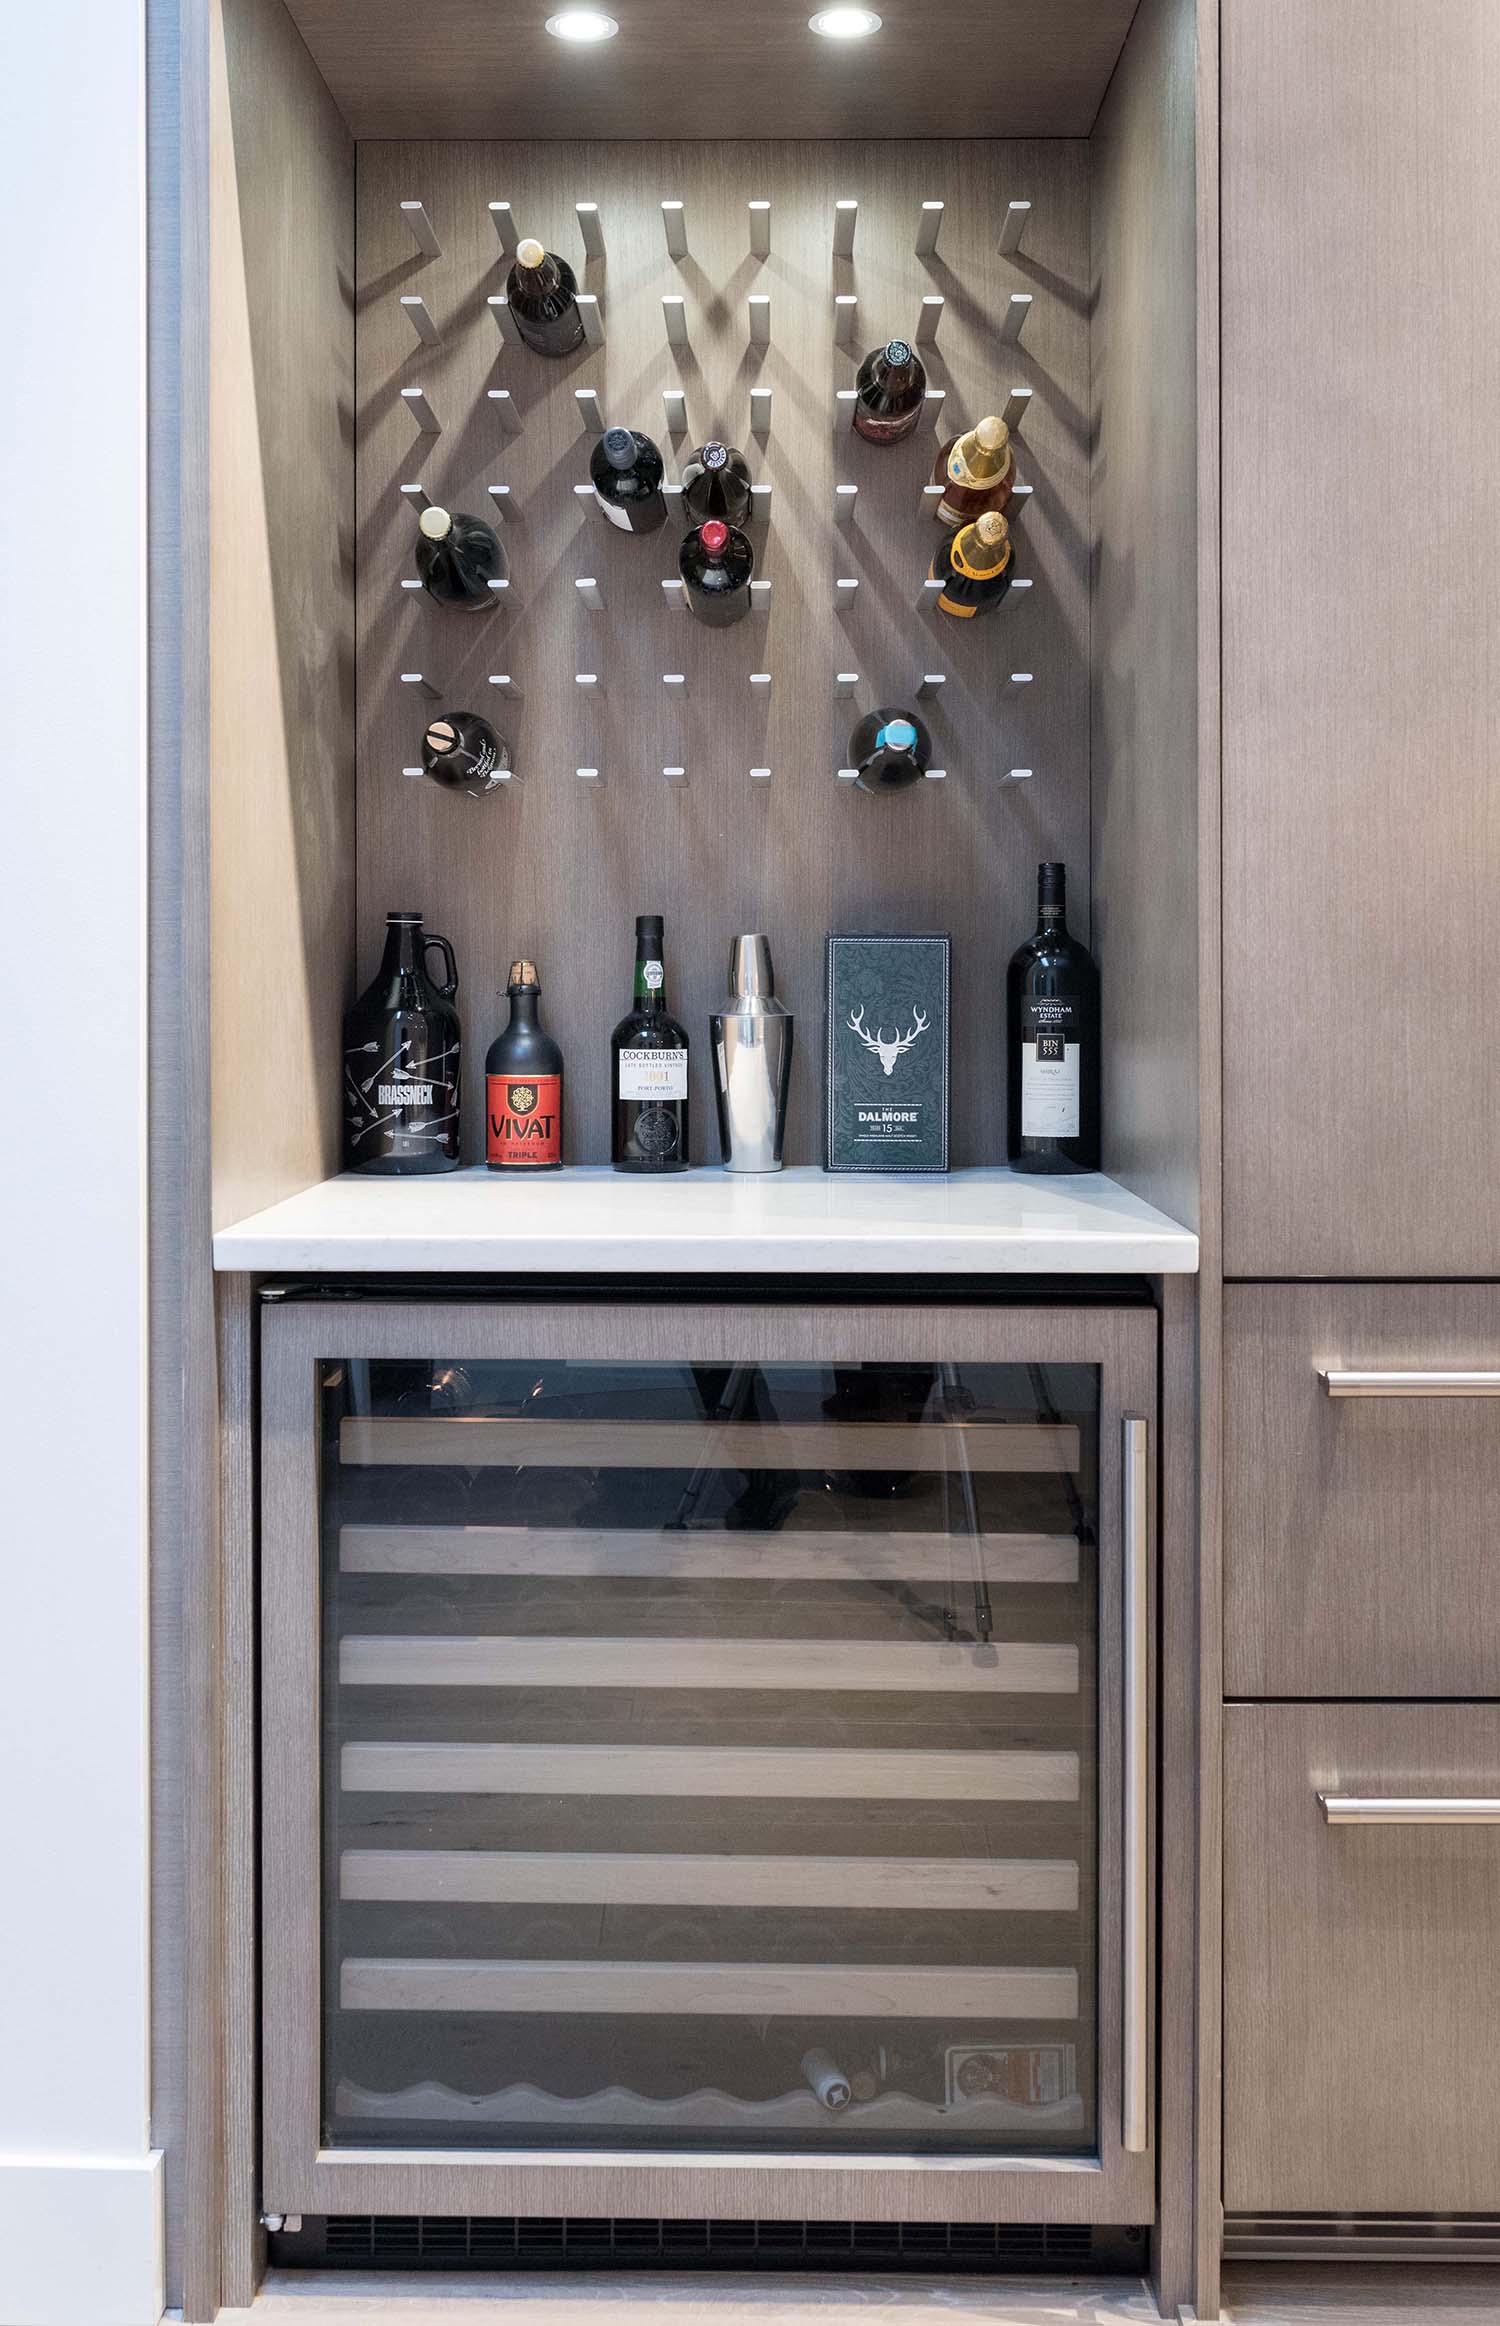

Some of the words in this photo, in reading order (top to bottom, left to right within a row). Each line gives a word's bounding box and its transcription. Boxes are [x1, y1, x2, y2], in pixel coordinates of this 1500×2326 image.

[623, 1050, 684, 1060] COCKBURN'S
[378, 1084, 433, 1105] BRASSNECK
[858, 1111, 919, 1122] DALMORE
[491, 1114, 556, 1139] VIVAT
[882, 1124, 893, 1132] 15
[508, 1151, 538, 1159] TRIPLE
